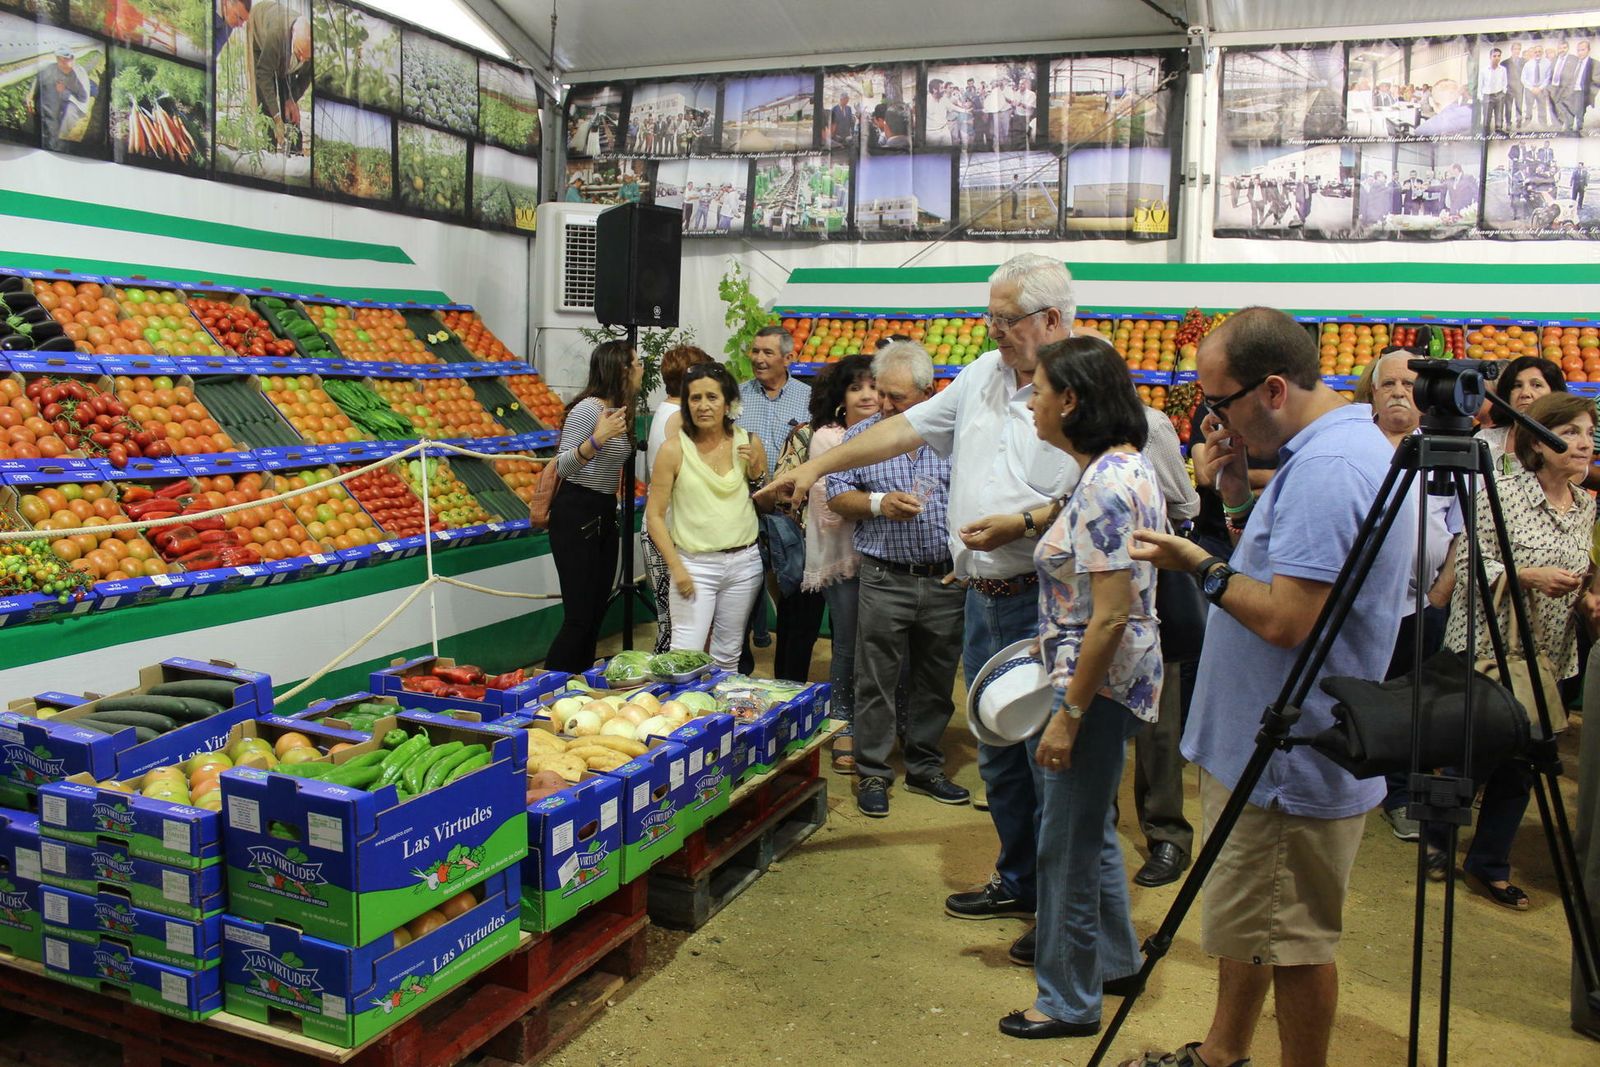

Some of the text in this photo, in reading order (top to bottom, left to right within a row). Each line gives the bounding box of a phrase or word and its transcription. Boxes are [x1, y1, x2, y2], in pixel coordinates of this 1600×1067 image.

[11, 748, 60, 774] LAS VIRTUDES
[98, 807, 130, 823] LAS VIRTUDES
[646, 809, 673, 827] LAS VIRTUDES
[403, 806, 493, 859] Las Virtudes
[97, 856, 130, 872] LAS VIRTUDES
[257, 852, 316, 881] LAS VIRTUDES
[580, 850, 604, 866] VIRTUDES
[98, 905, 133, 923] LAS VIRTUDES
[433, 914, 506, 973] Las Virtudes
[98, 954, 130, 972] LAS VIRTUDES
[251, 955, 311, 986] LAS VIRTUDES
